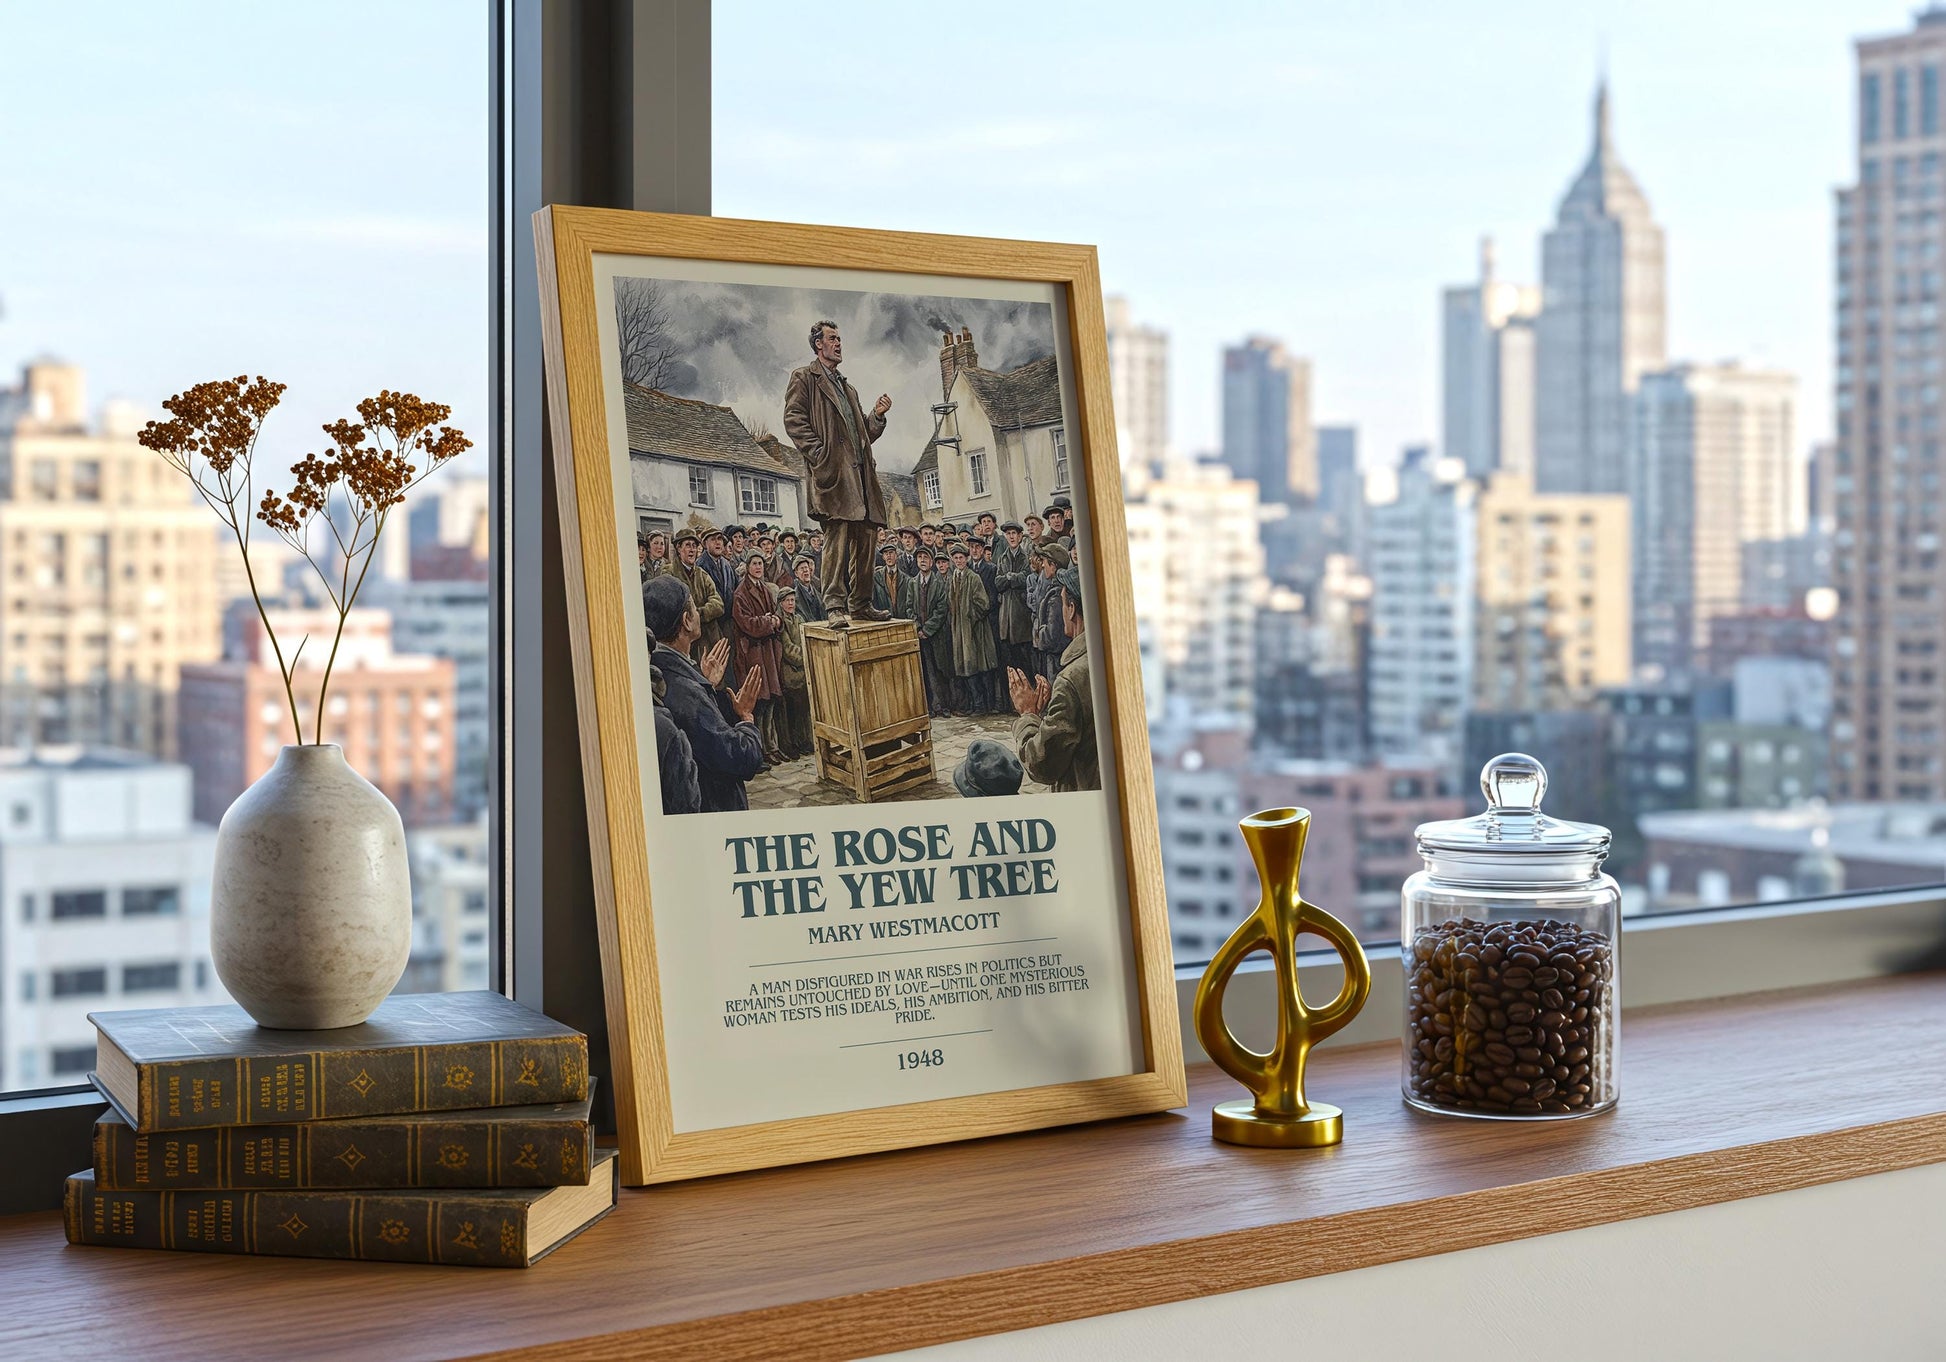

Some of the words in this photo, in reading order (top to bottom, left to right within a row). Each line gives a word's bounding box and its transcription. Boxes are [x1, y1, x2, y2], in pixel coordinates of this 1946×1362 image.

[724, 832, 820, 875] THE
[831, 823, 954, 868] ROSE
[967, 818, 1057, 858] AND
[732, 875, 827, 919] THE
[838, 867, 938, 910] YEW
[949, 858, 1060, 901] TREE
[807, 923, 864, 945] MARY
[868, 911, 1001, 939] WESTMACOTT
[725, 995, 786, 1013] REMAINS
[788, 986, 871, 1007] UNTOUCHED
[874, 984, 891, 998] BY
[979, 972, 1007, 987] ONE
[1009, 964, 1085, 984] MYSTERIOUS
[749, 983, 759, 996] A
[762, 980, 792, 995] MAN
[795, 972, 874, 992] DISFIGURED
[877, 970, 891, 984] IN
[894, 967, 924, 982] WAR
[926, 963, 962, 979] RISES
[965, 961, 978, 975] IN
[981, 956, 1036, 973] POLITICS
[1038, 953, 1062, 967] BUT
[723, 1010, 777, 1028] WOMAN
[779, 1005, 822, 1022] TESTS
[825, 1003, 848, 1017] HIS
[850, 998, 900, 1015] IDEALS,
[903, 995, 926, 1009] HIS
[929, 988, 993, 1007] AMBITION,
[996, 985, 1022, 999] AND
[1025, 982, 1046, 996] HIS
[1048, 978, 1090, 994] BITTER
[895, 1008, 936, 1024] PRIDE.
[897, 1048, 945, 1071] 1948
